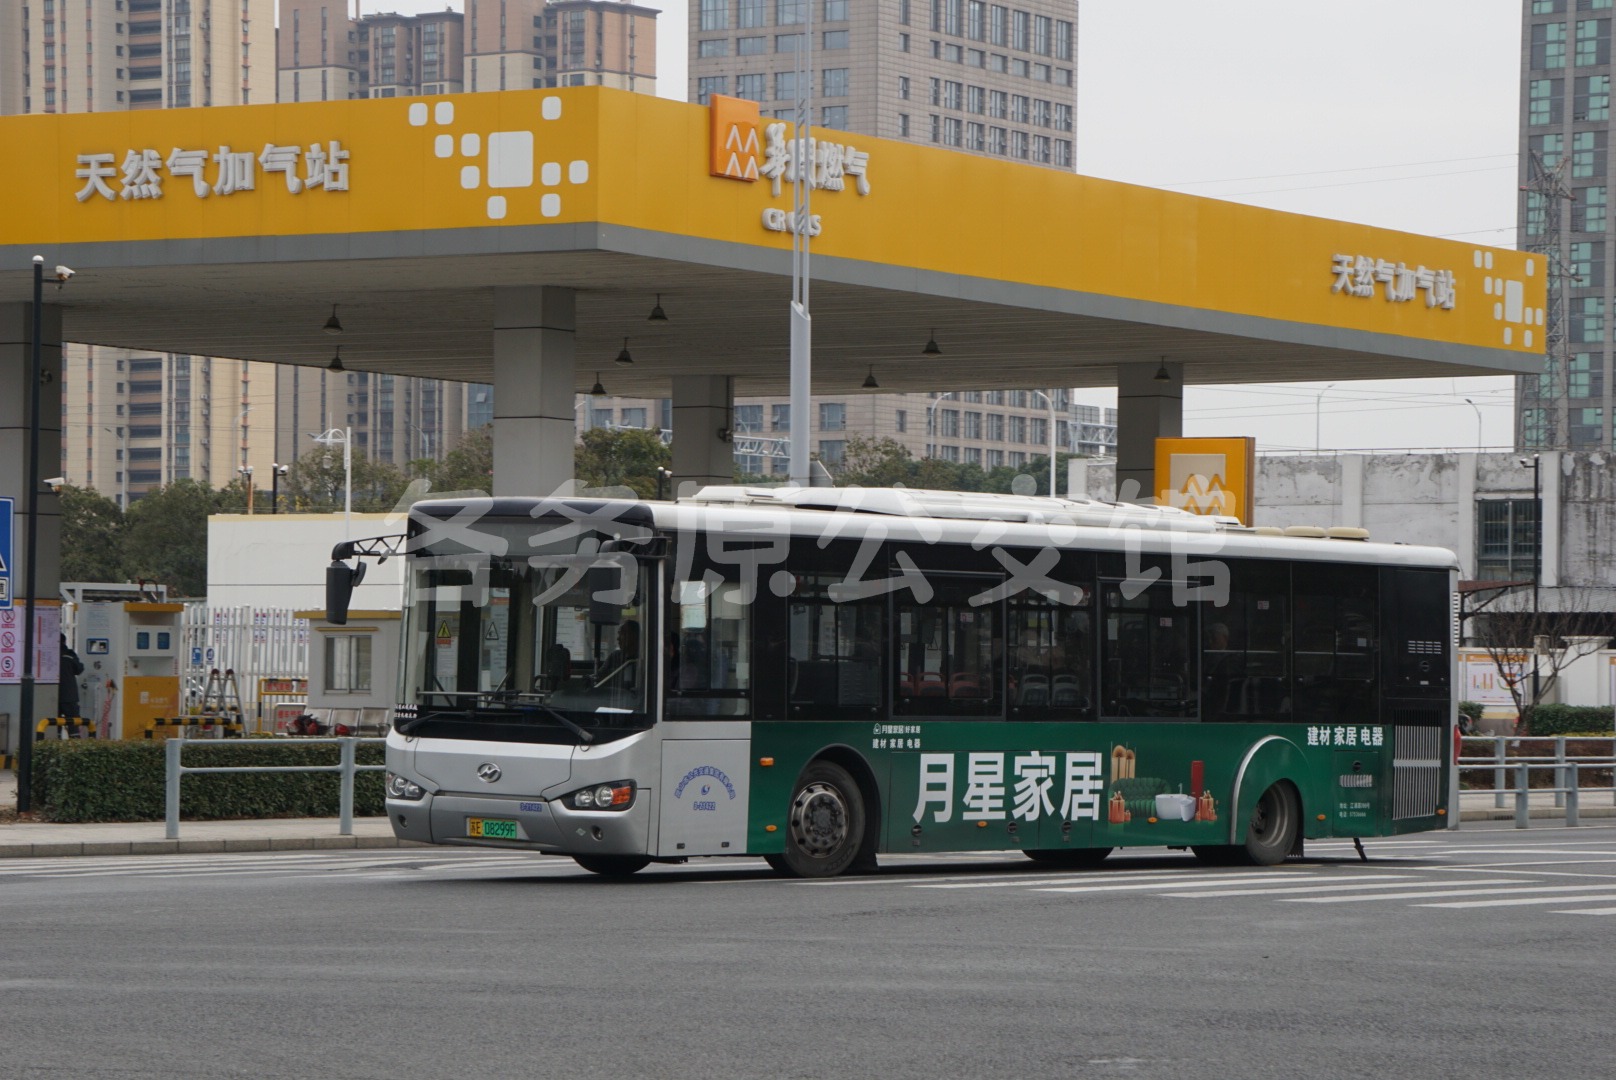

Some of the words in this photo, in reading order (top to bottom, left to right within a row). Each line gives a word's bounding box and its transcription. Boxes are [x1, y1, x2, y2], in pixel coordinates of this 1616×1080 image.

[75, 140, 351, 202] 天然气加气站
[1331, 253, 1456, 310] 天然气加气站
[1307, 726, 1331, 745] 建材
[1334, 726, 1357, 745] 家居
[1361, 726, 1383, 745] 电器
[912, 751, 1104, 823] 月星家居
